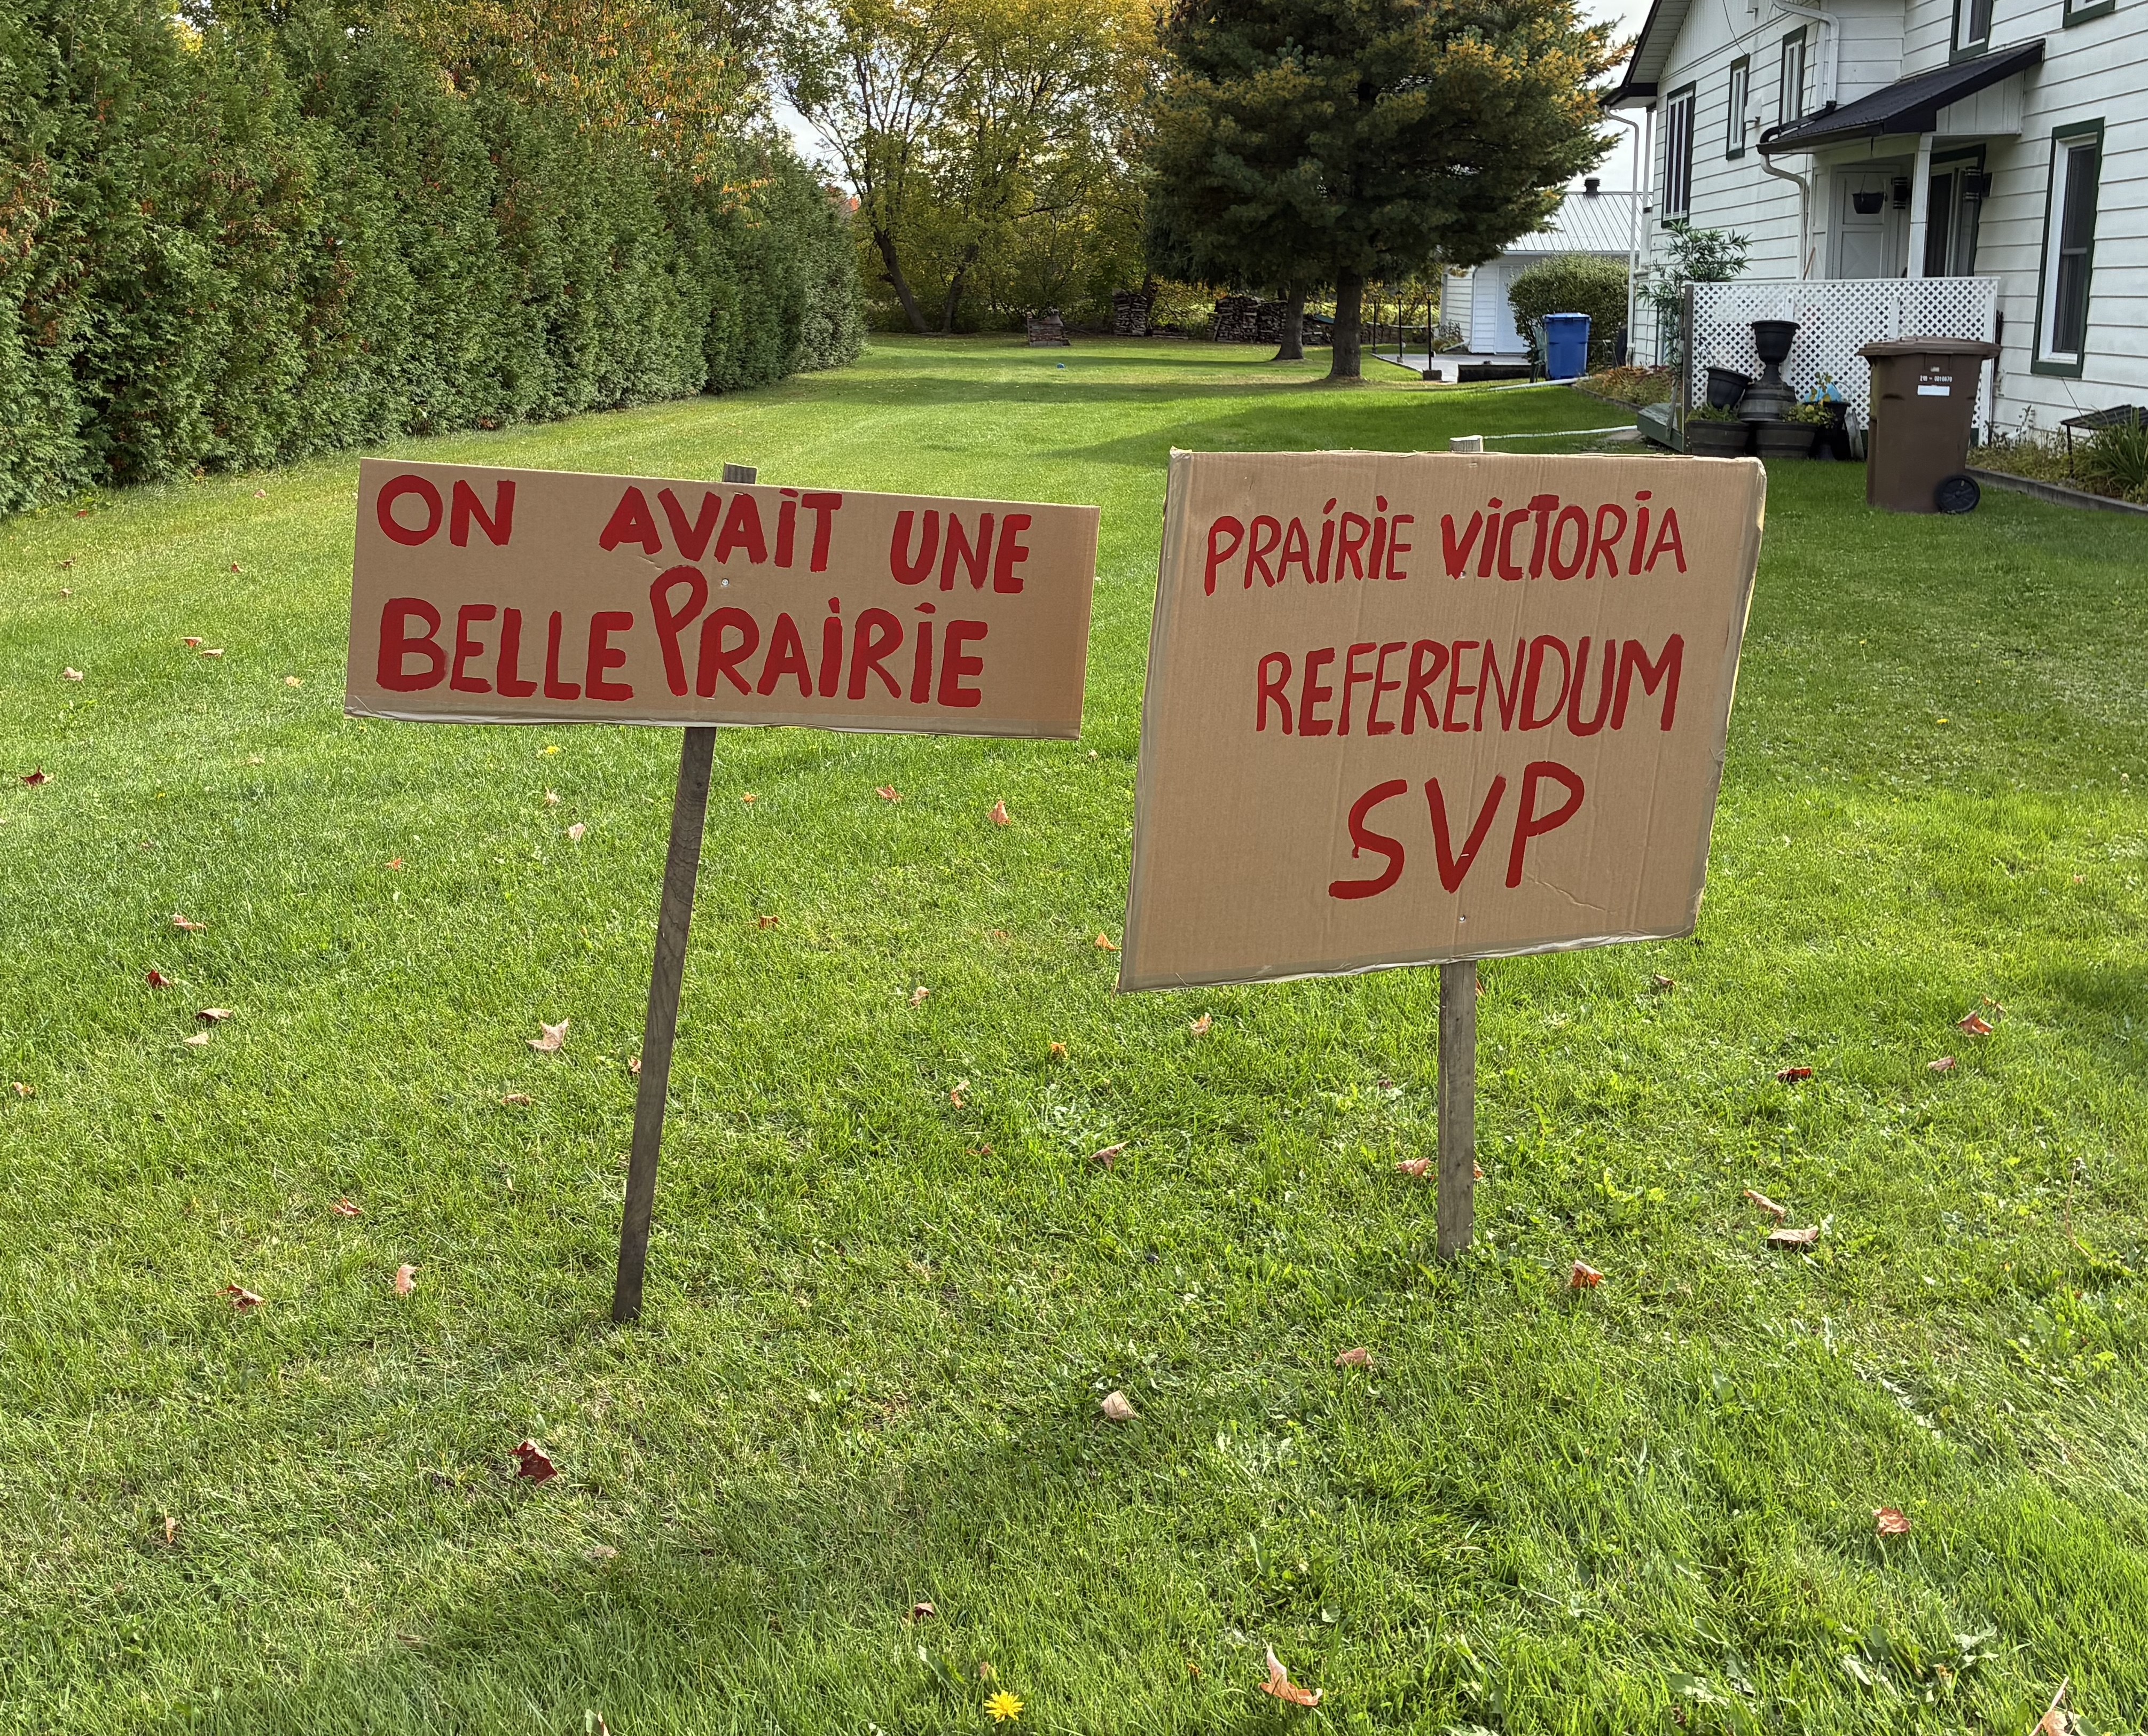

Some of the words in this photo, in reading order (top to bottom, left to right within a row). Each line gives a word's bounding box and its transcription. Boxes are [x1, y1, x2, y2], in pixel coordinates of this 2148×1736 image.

[377, 475, 516, 547] ON
[599, 487, 843, 573] AVAIT
[890, 510, 1032, 594] UNE
[1204, 495, 1415, 597] PRAIRIE
[1440, 491, 1687, 581] VICTORIA
[377, 598, 634, 701] BELLE
[649, 565, 989, 708] PRAIRIE
[1256, 634, 1684, 737] REFERENDUM
[1328, 761, 1585, 900] SVP
